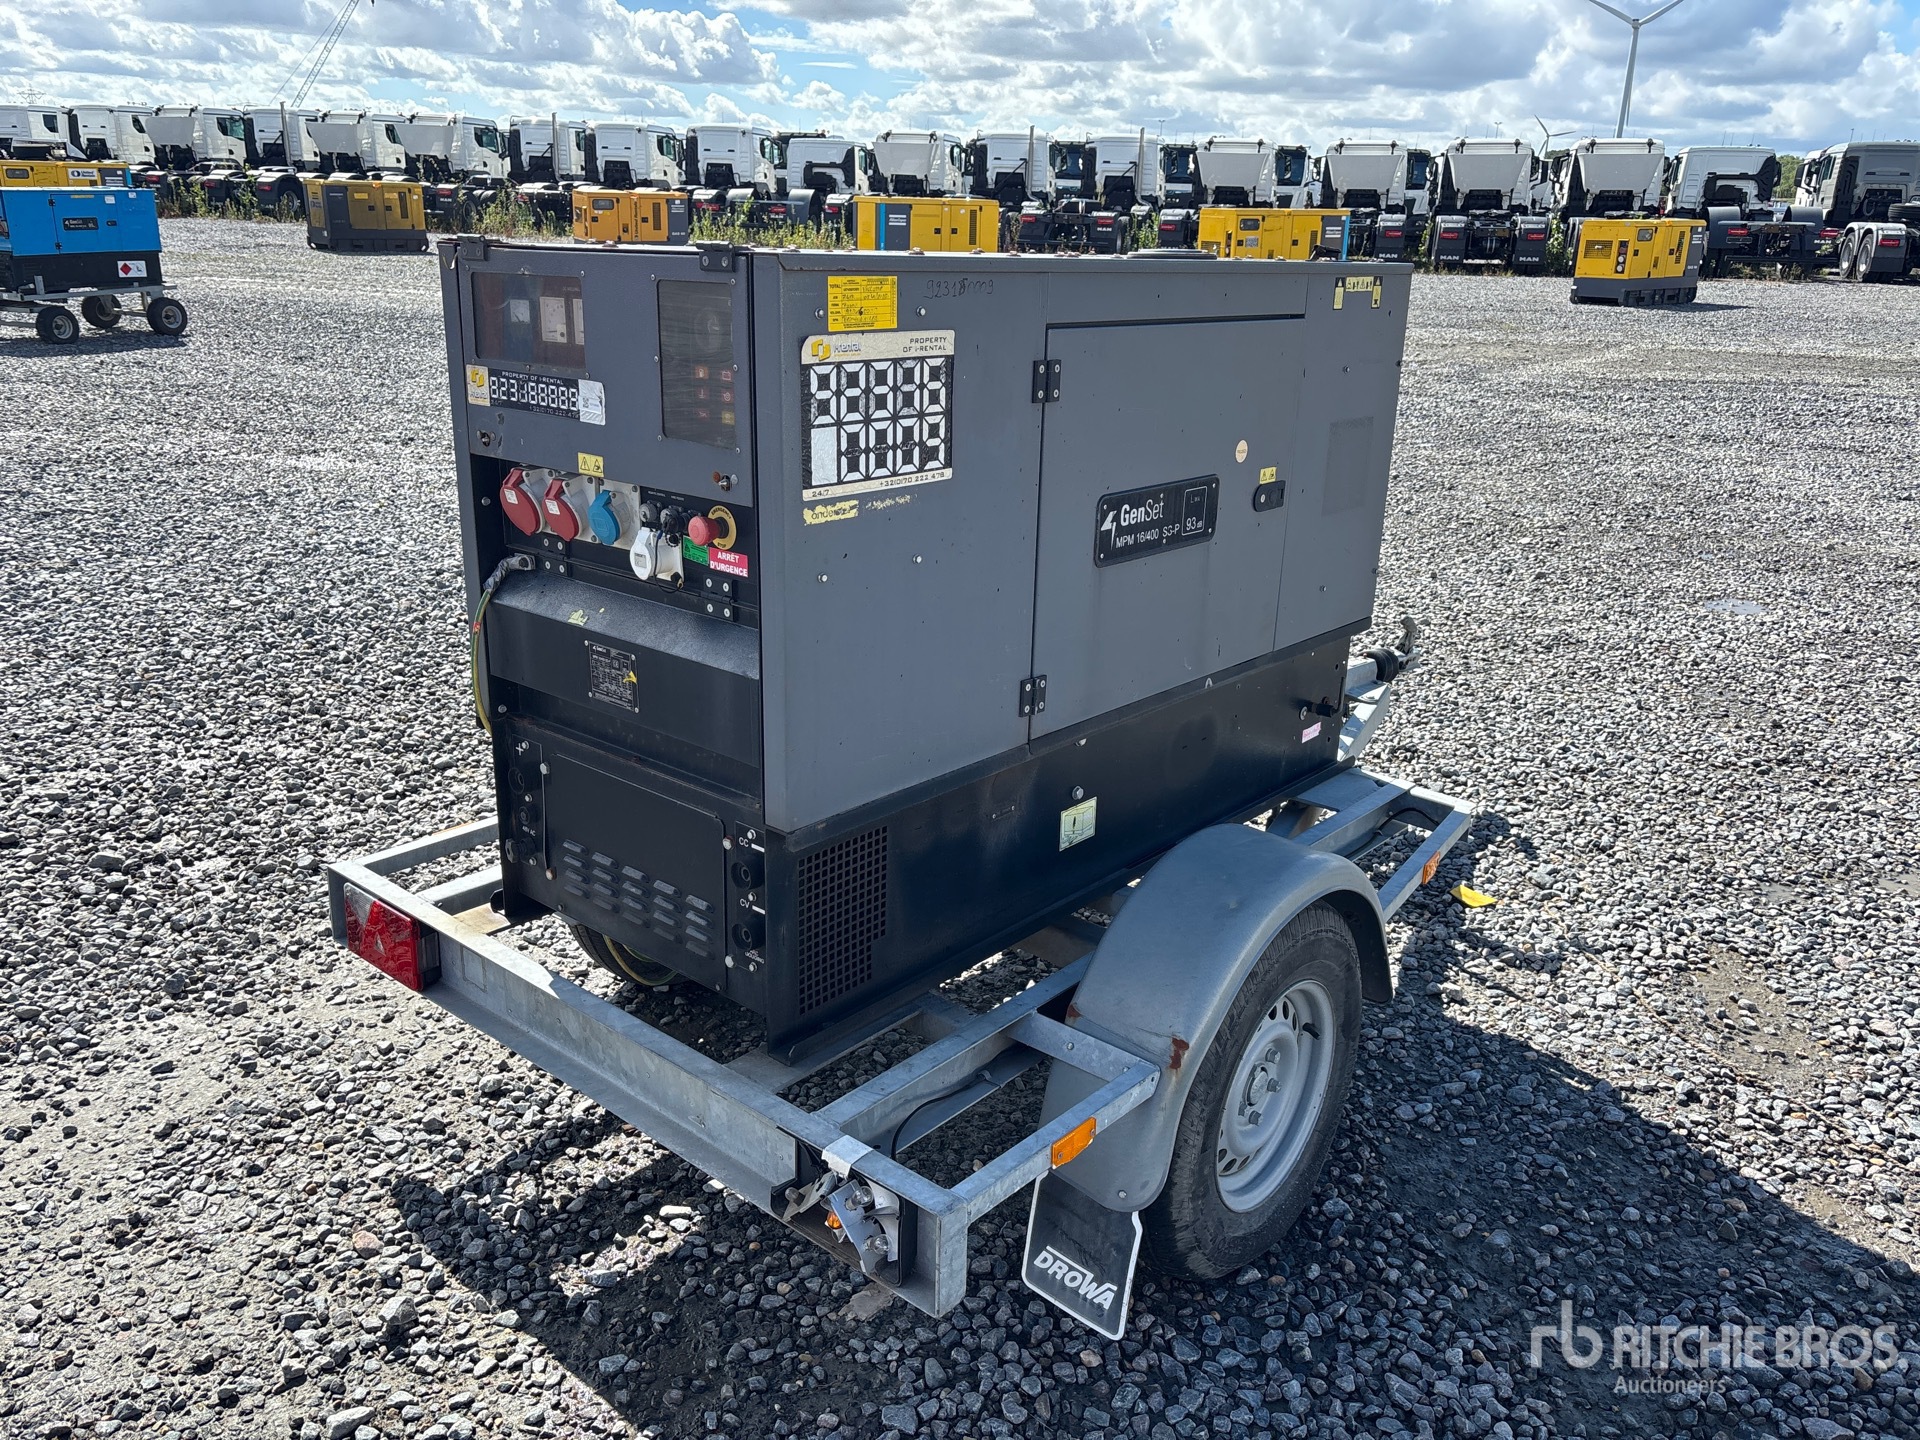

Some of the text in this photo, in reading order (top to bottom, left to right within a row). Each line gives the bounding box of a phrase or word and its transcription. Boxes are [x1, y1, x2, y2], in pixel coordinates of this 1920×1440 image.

[502, 371, 529, 381] PROPERTY
[915, 474, 929, 482] 222
[931, 471, 945, 479] 478
[1120, 499, 1164, 526] GenSet
[1186, 517, 1197, 531] 93
[1116, 534, 1135, 549] MPM
[1137, 528, 1160, 544] 16/400
[717, 551, 740, 564] ARRÊT
[709, 560, 749, 578] D'URGENCE
[738, 836, 749, 848] CC
[739, 898, 750, 909] CV
[1033, 1249, 1118, 1310] DROWA
